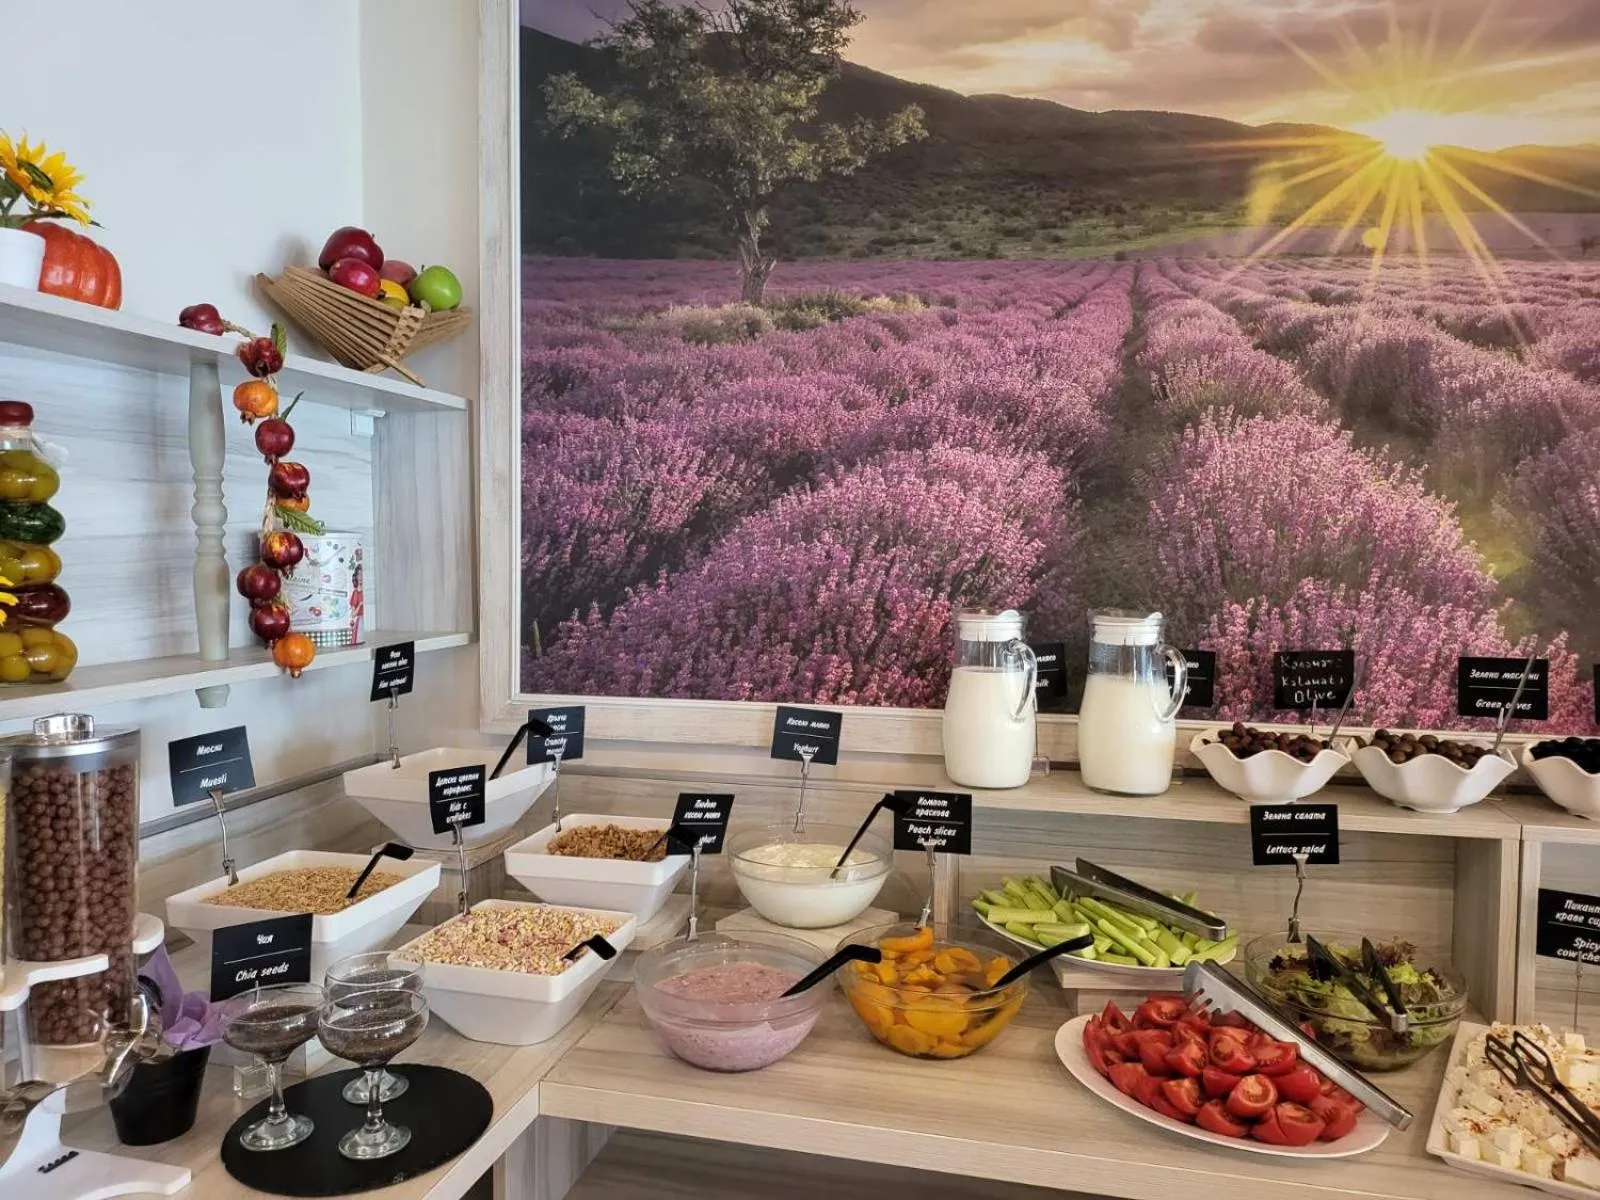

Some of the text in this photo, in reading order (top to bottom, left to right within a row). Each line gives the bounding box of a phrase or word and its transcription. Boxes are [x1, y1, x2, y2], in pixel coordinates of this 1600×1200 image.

[1469, 668, 1540, 680] Зелени маслни
[1294, 689, 1336, 704] Olive
[1475, 699, 1532, 711] Green oves
[786, 717, 809, 727] Кисело
[196, 743, 223, 756] Мюсли
[200, 773, 228, 789] Muesli
[917, 796, 948, 807] Компот
[915, 808, 950, 818] праскова
[1263, 810, 1327, 821] Зелена салата
[907, 823, 957, 836] Peach slices
[1265, 844, 1327, 854] Lettuce salad
[1555, 912, 1585, 923] краве
[1572, 937, 1600, 953] Spicy
[1556, 948, 1578, 958] cow
[235, 962, 289, 982] Chia seeds
